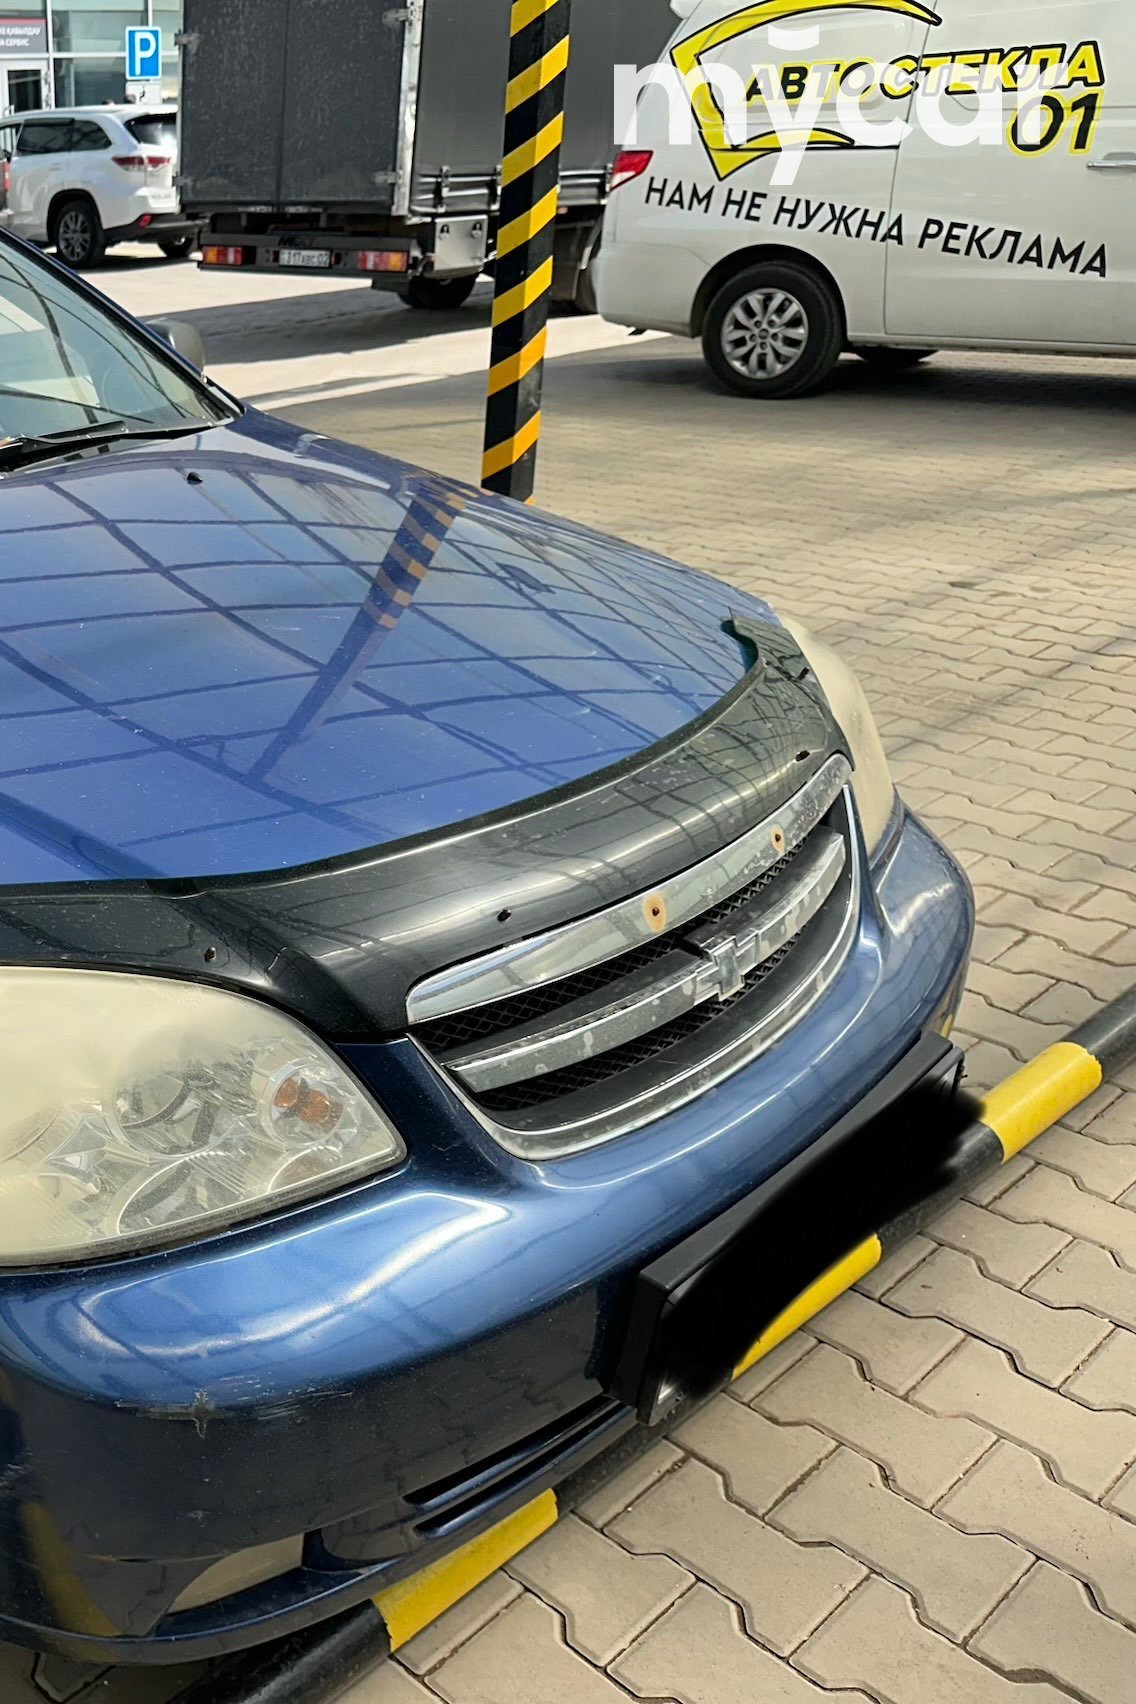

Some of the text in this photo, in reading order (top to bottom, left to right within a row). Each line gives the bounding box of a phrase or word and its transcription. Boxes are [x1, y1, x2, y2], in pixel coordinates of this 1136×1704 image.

[135, 31, 157, 76] P
[744, 40, 1105, 103] АВТОСТЕКЛА
[1010, 90, 1102, 154] 01
[644, 176, 1107, 278] НАМ НЕ НУЖНА РЕКЛАМА
